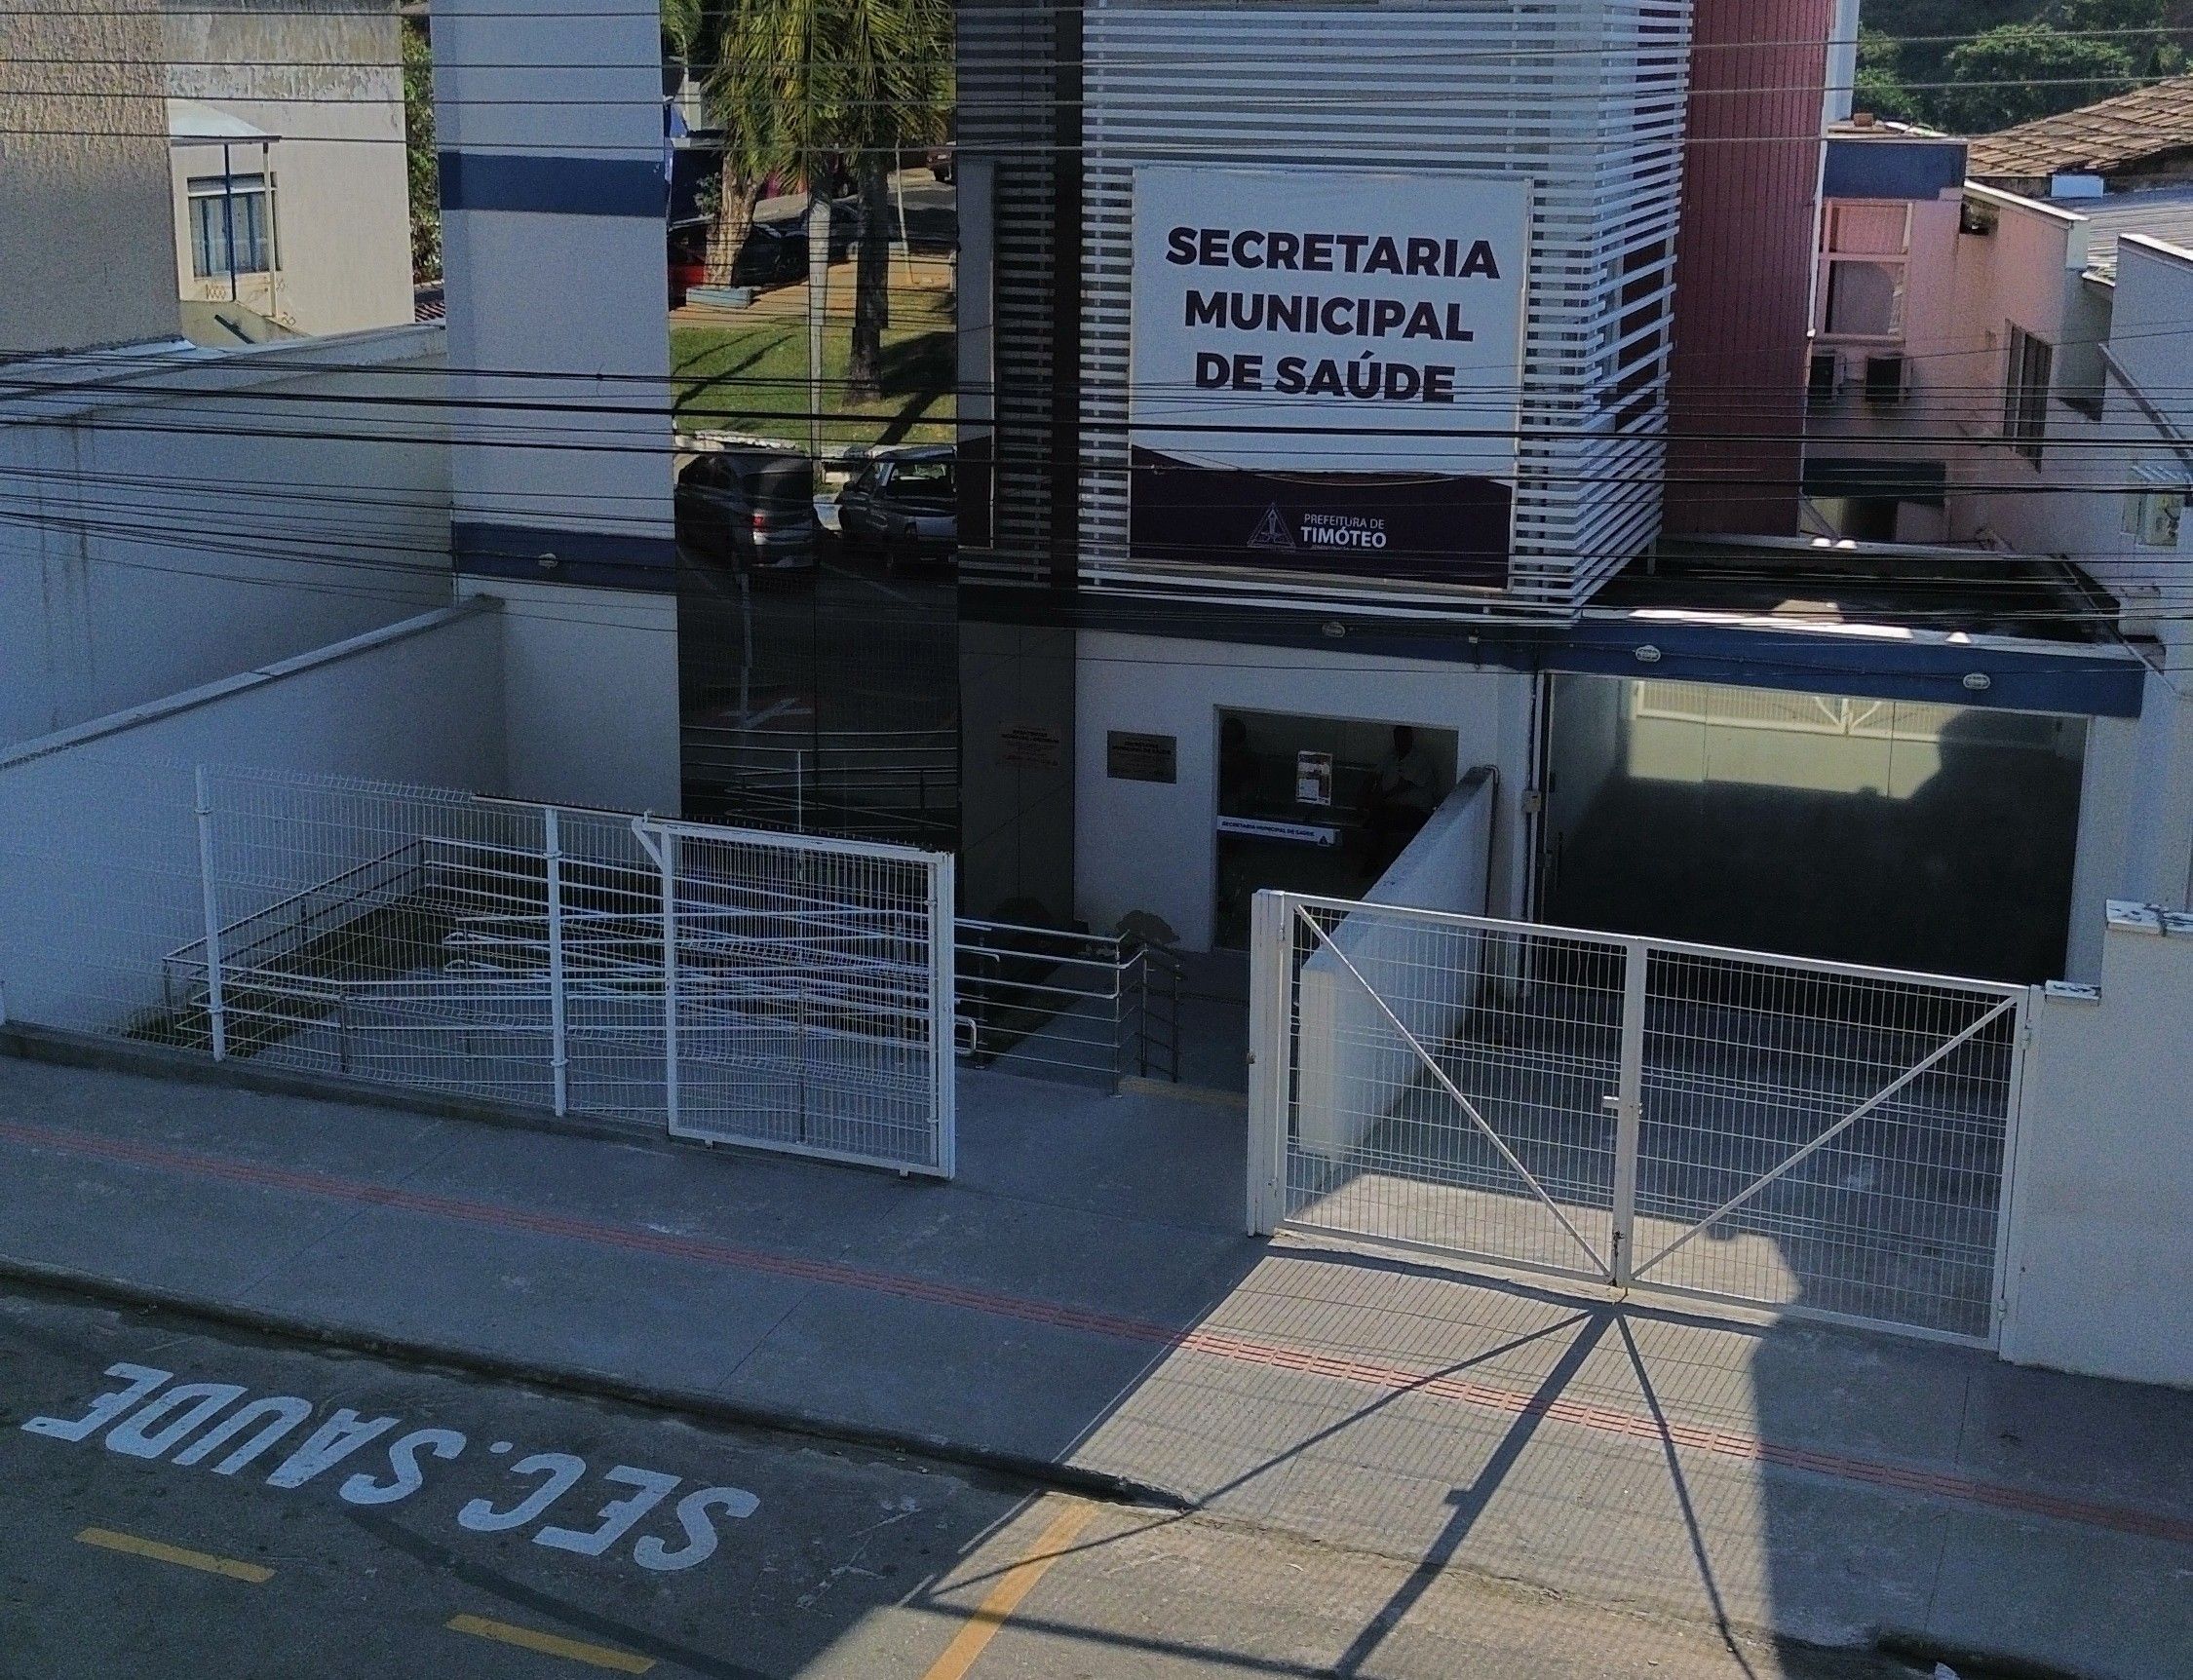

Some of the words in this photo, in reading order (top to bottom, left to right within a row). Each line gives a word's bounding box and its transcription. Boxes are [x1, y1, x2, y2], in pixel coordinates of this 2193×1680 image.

[1166, 226, 1501, 280] SECRETARIA
[1184, 290, 1475, 342] MUNICIPAL
[1195, 352, 1263, 392] DE
[1274, 350, 1456, 404] SAÚDE
[1300, 526, 1387, 548] TIMÓTEO
[1304, 513, 1366, 528] PREFEITURA
[1369, 518, 1385, 530] DE
[19, 1361, 467, 1505] SAUDE
[457, 1440, 761, 1571] SEC.
